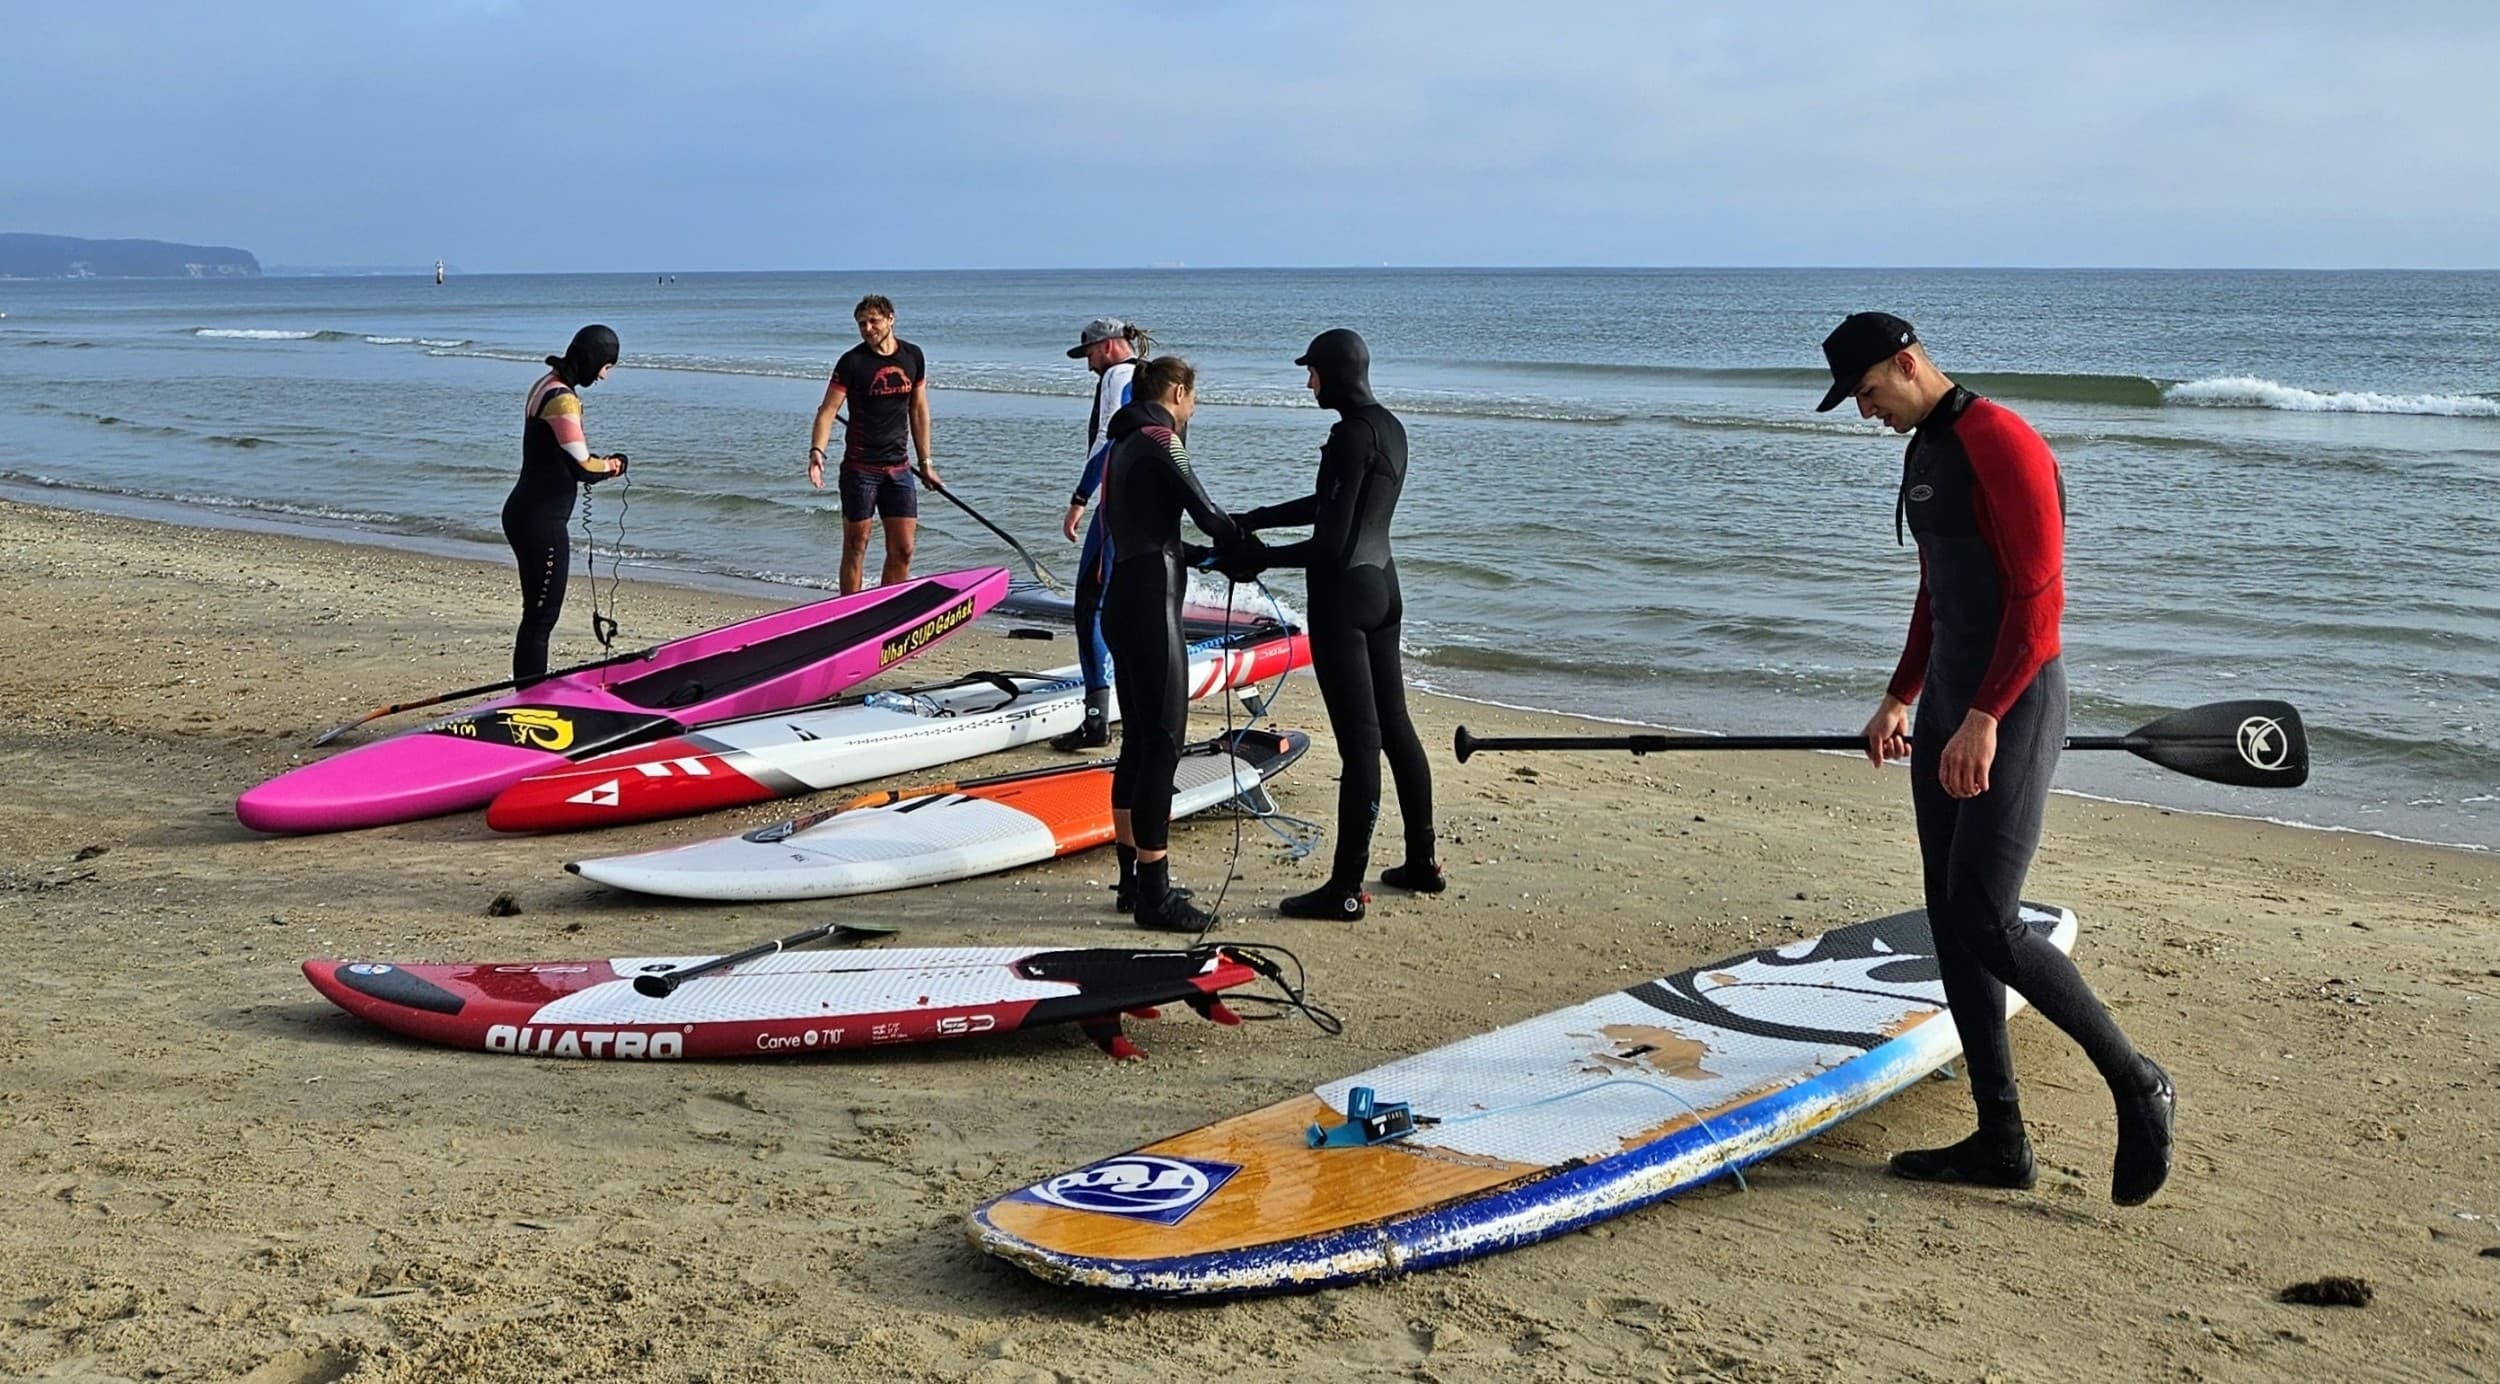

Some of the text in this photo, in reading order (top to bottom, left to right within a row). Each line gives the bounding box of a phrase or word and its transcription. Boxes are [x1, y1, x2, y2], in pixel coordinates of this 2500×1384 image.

[910, 620, 935, 650] SUP
[936, 597, 974, 634] Gdańsk
[756, 1033, 800, 1050] Carve
